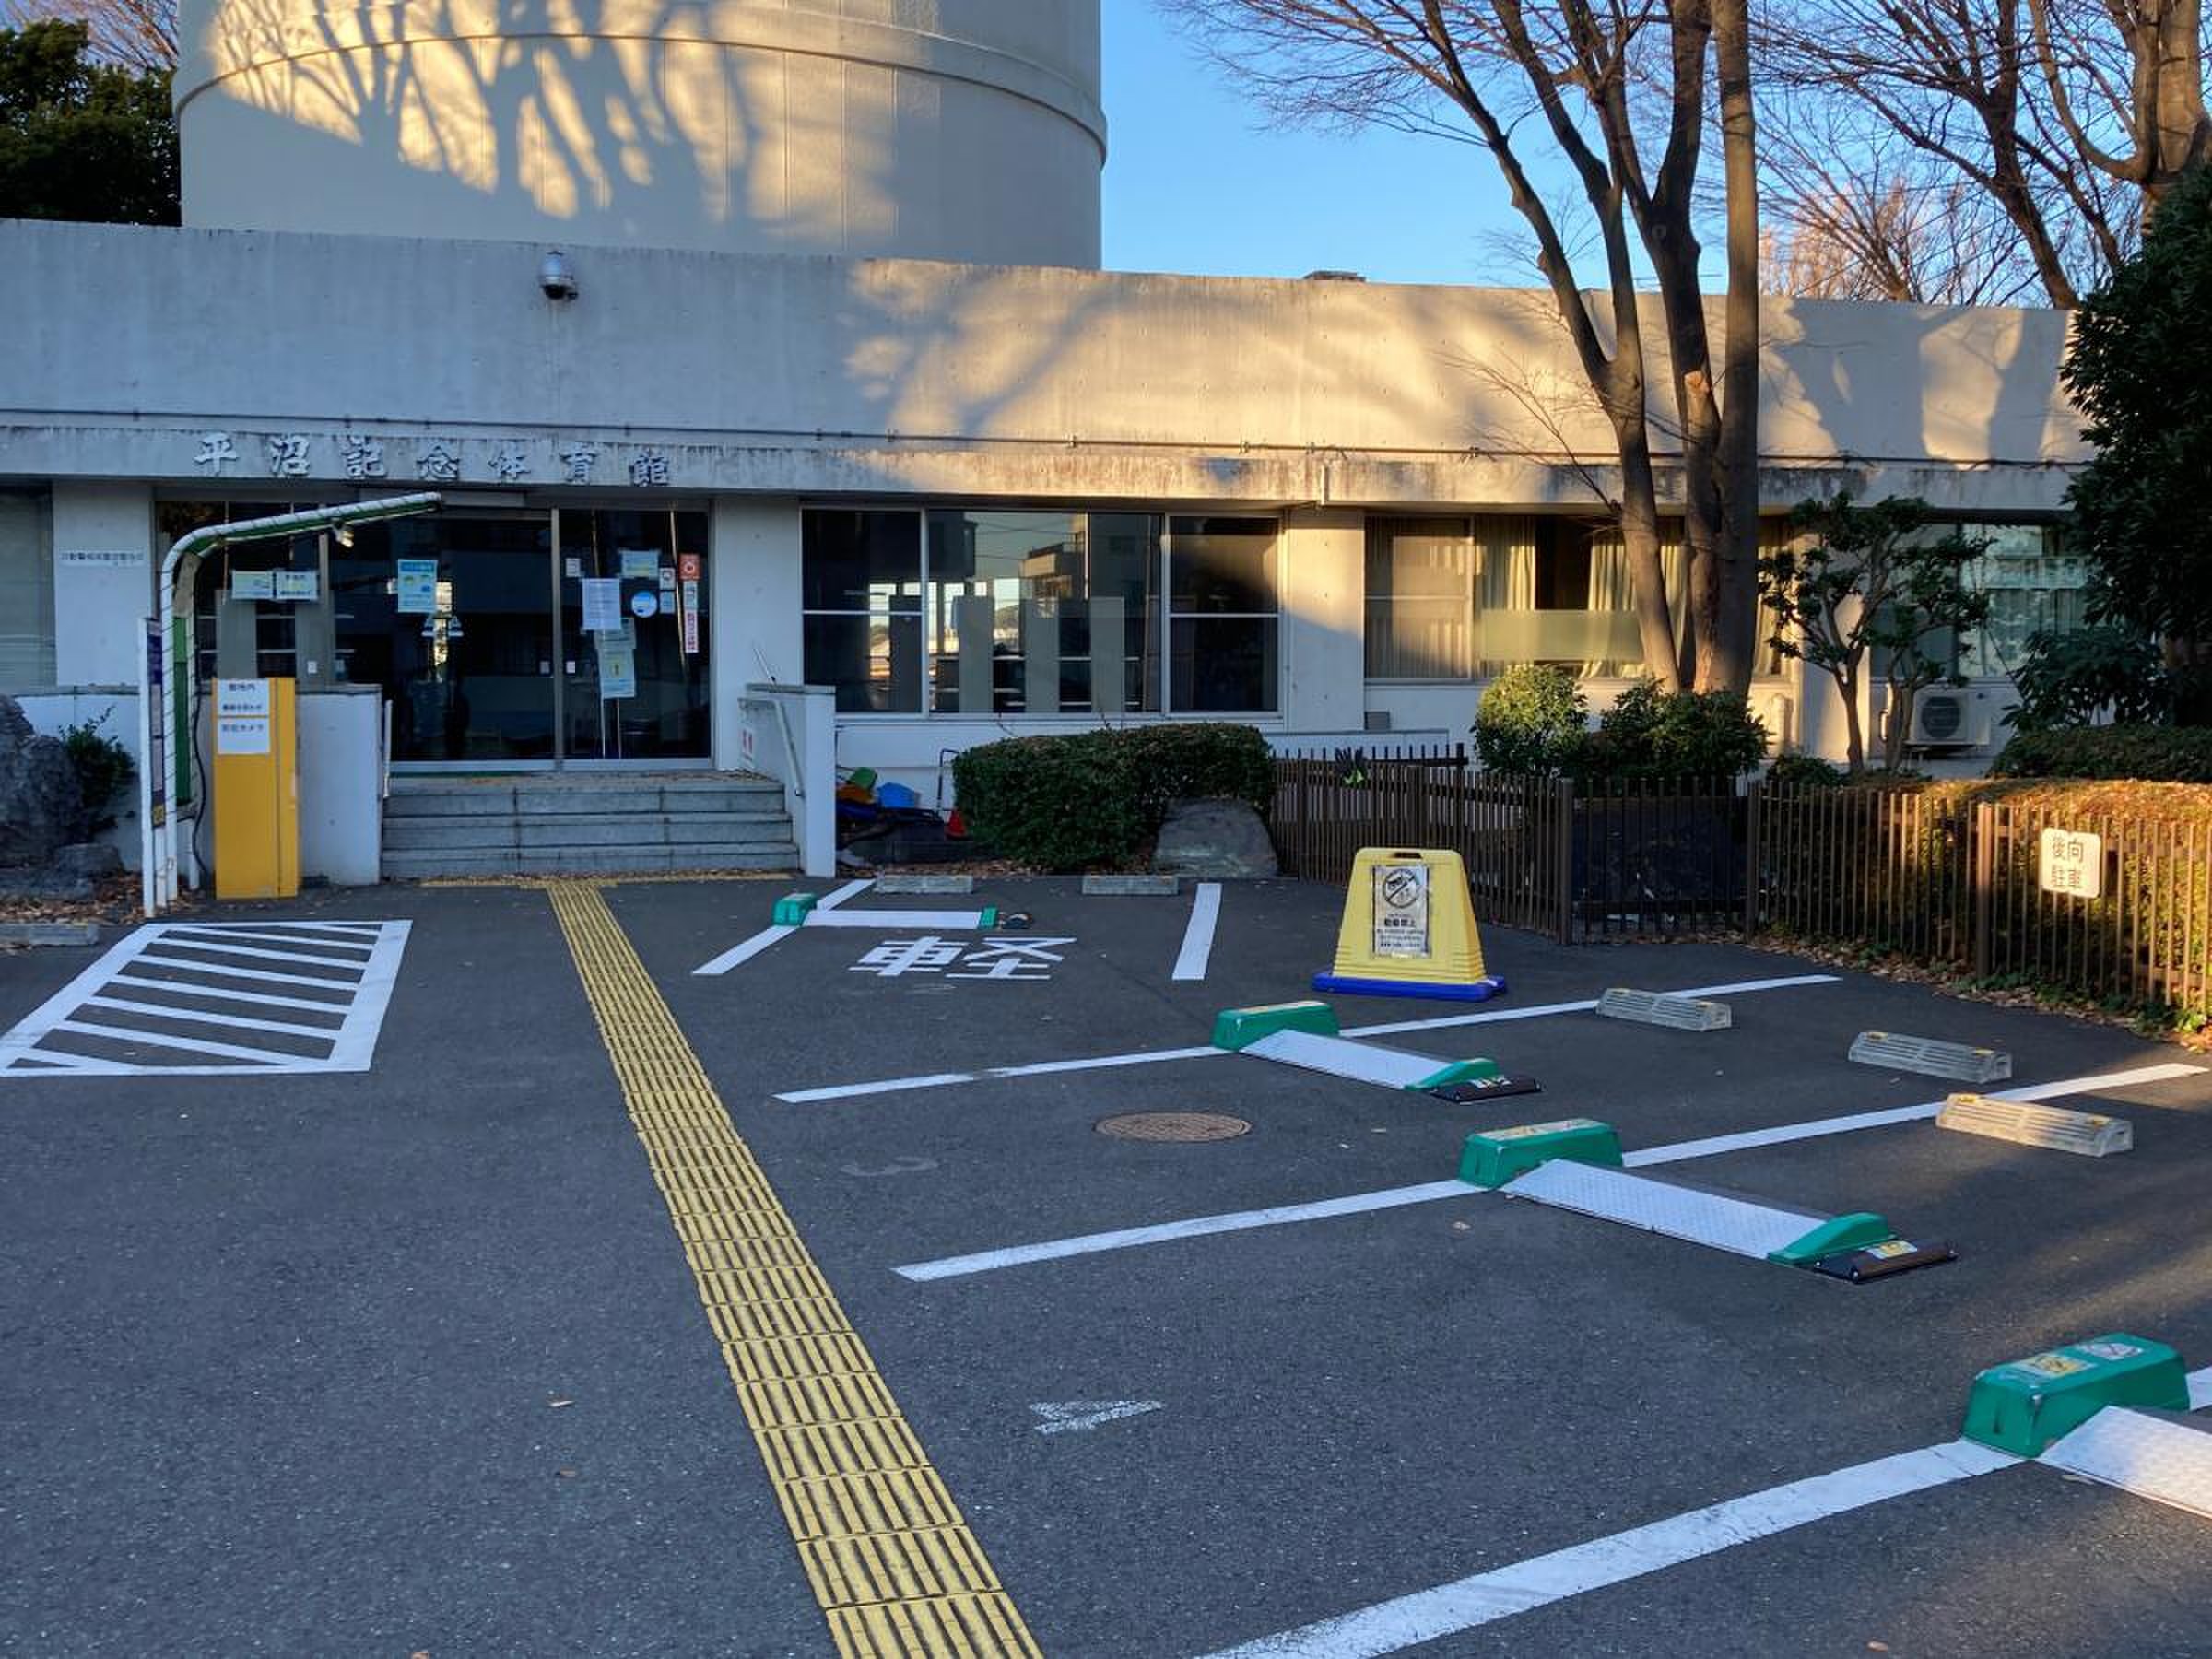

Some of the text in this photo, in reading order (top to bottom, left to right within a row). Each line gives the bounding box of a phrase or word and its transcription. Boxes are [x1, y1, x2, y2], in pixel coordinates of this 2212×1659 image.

[194, 432, 669, 487] 平沼記念体育館
[2050, 835, 2084, 863] 後向
